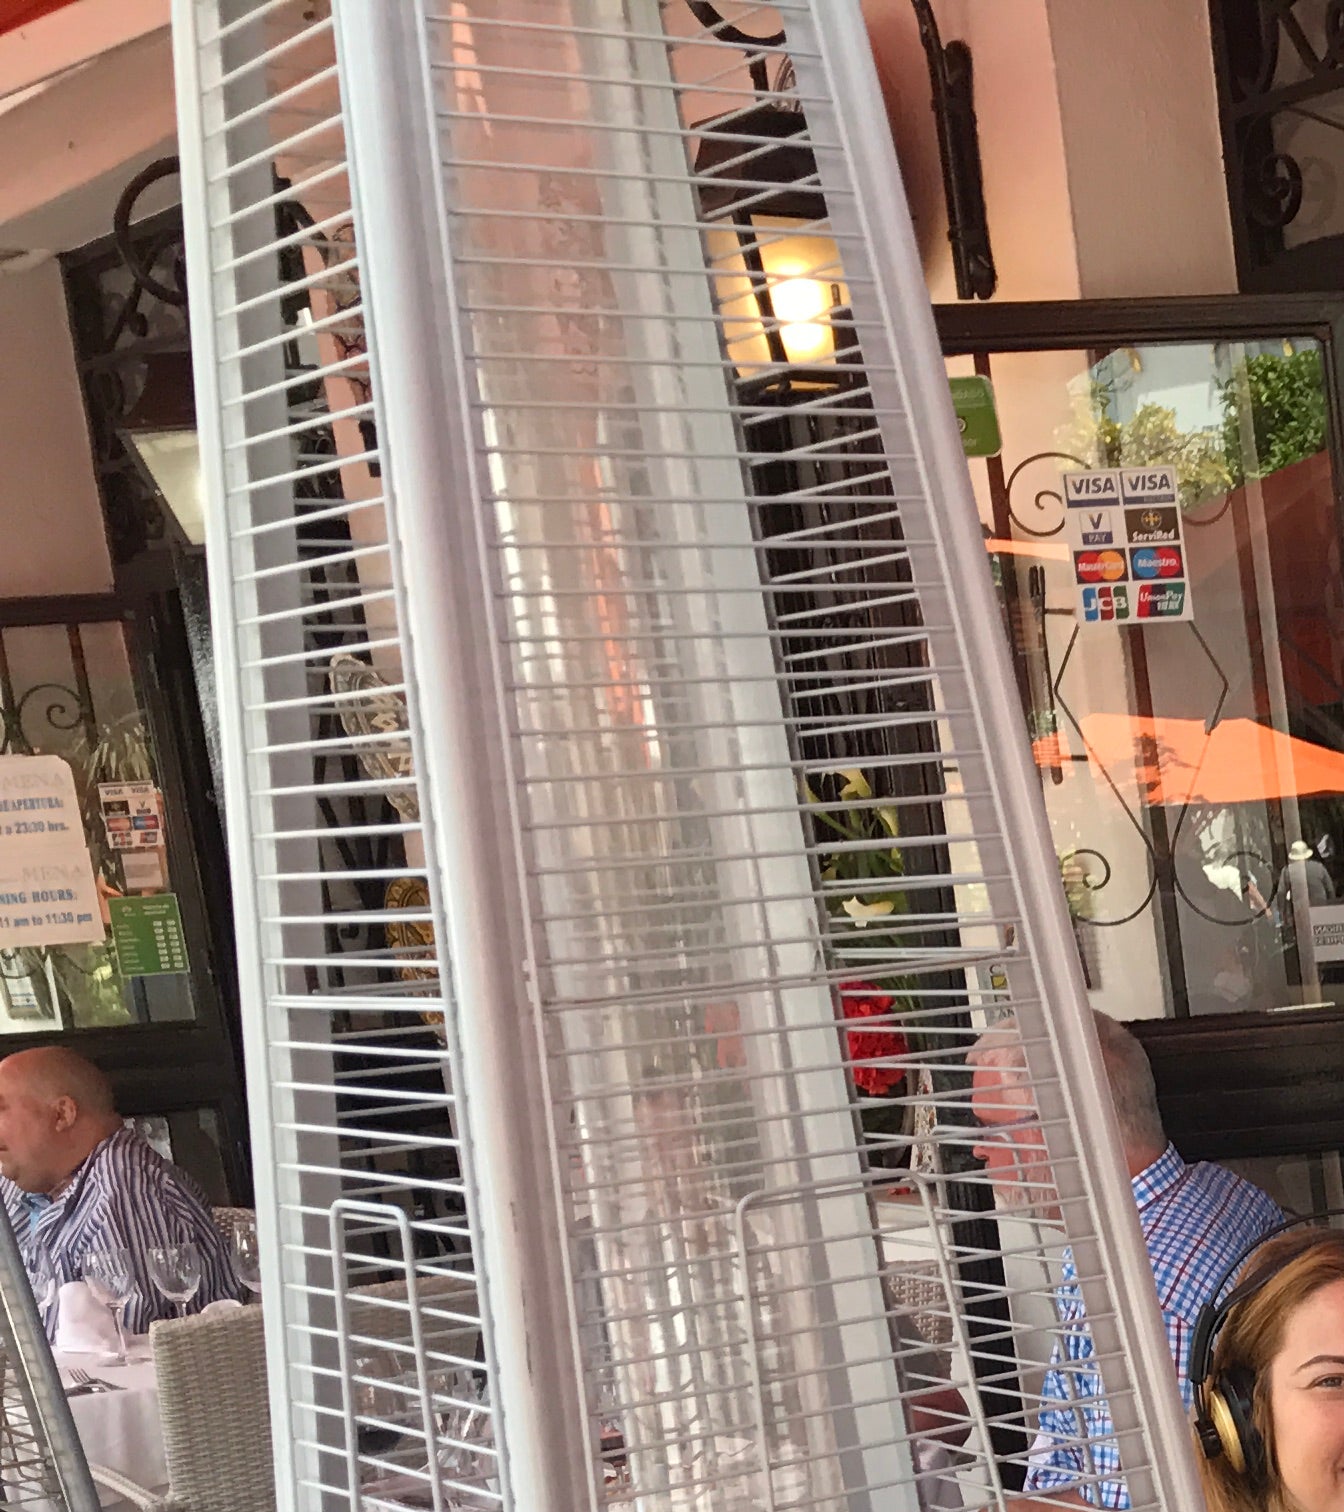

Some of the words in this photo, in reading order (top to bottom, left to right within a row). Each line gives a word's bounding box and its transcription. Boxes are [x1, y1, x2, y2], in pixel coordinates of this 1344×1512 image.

[1072, 477, 1115, 495] VISA
[1127, 473, 1171, 492] VISA
[1088, 532, 1108, 543] PAY
[1132, 528, 1176, 542] ServiRed
[1084, 595, 1128, 611] JCB
